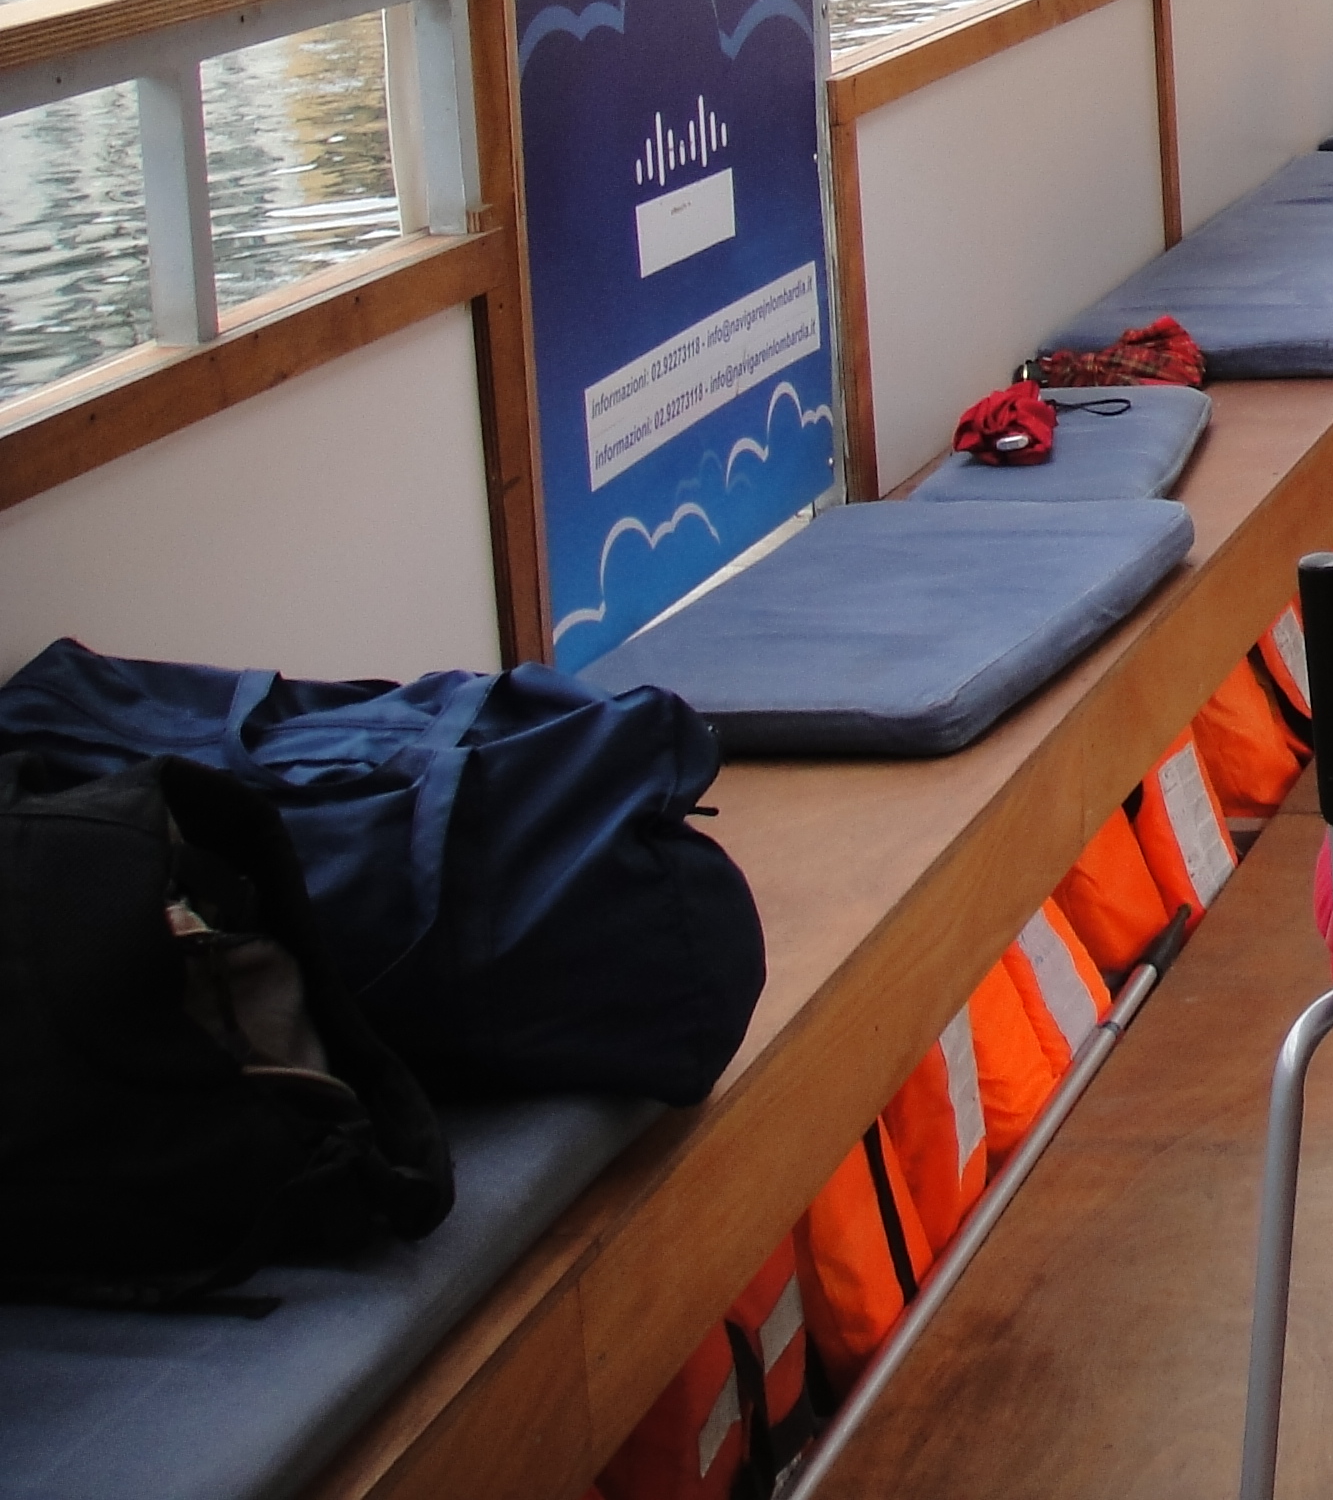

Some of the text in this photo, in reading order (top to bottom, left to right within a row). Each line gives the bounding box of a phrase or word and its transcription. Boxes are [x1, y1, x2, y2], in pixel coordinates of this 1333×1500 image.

[651, 336, 700, 382] 02.92273118
[595, 416, 652, 470] informazioni:
[654, 382, 704, 430] 02.92273118
